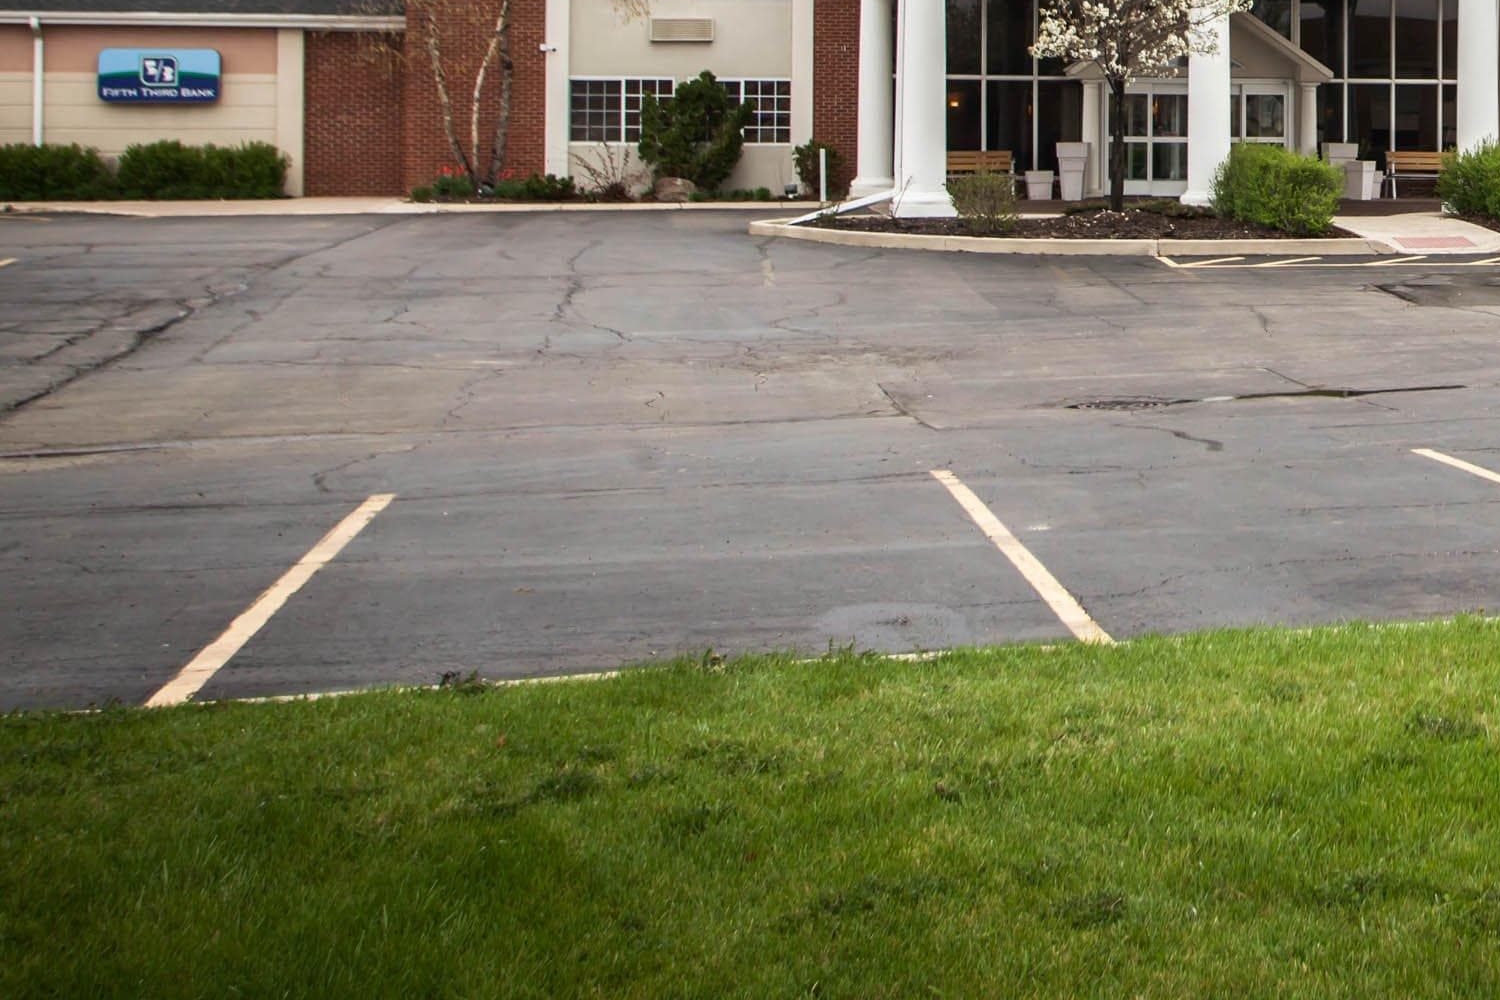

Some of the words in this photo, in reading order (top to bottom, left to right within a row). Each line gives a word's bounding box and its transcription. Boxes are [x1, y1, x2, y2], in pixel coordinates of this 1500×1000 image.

[102, 88, 138, 97] FIFTH
[141, 88, 178, 97] THIRD
[181, 88, 216, 97] BANK
